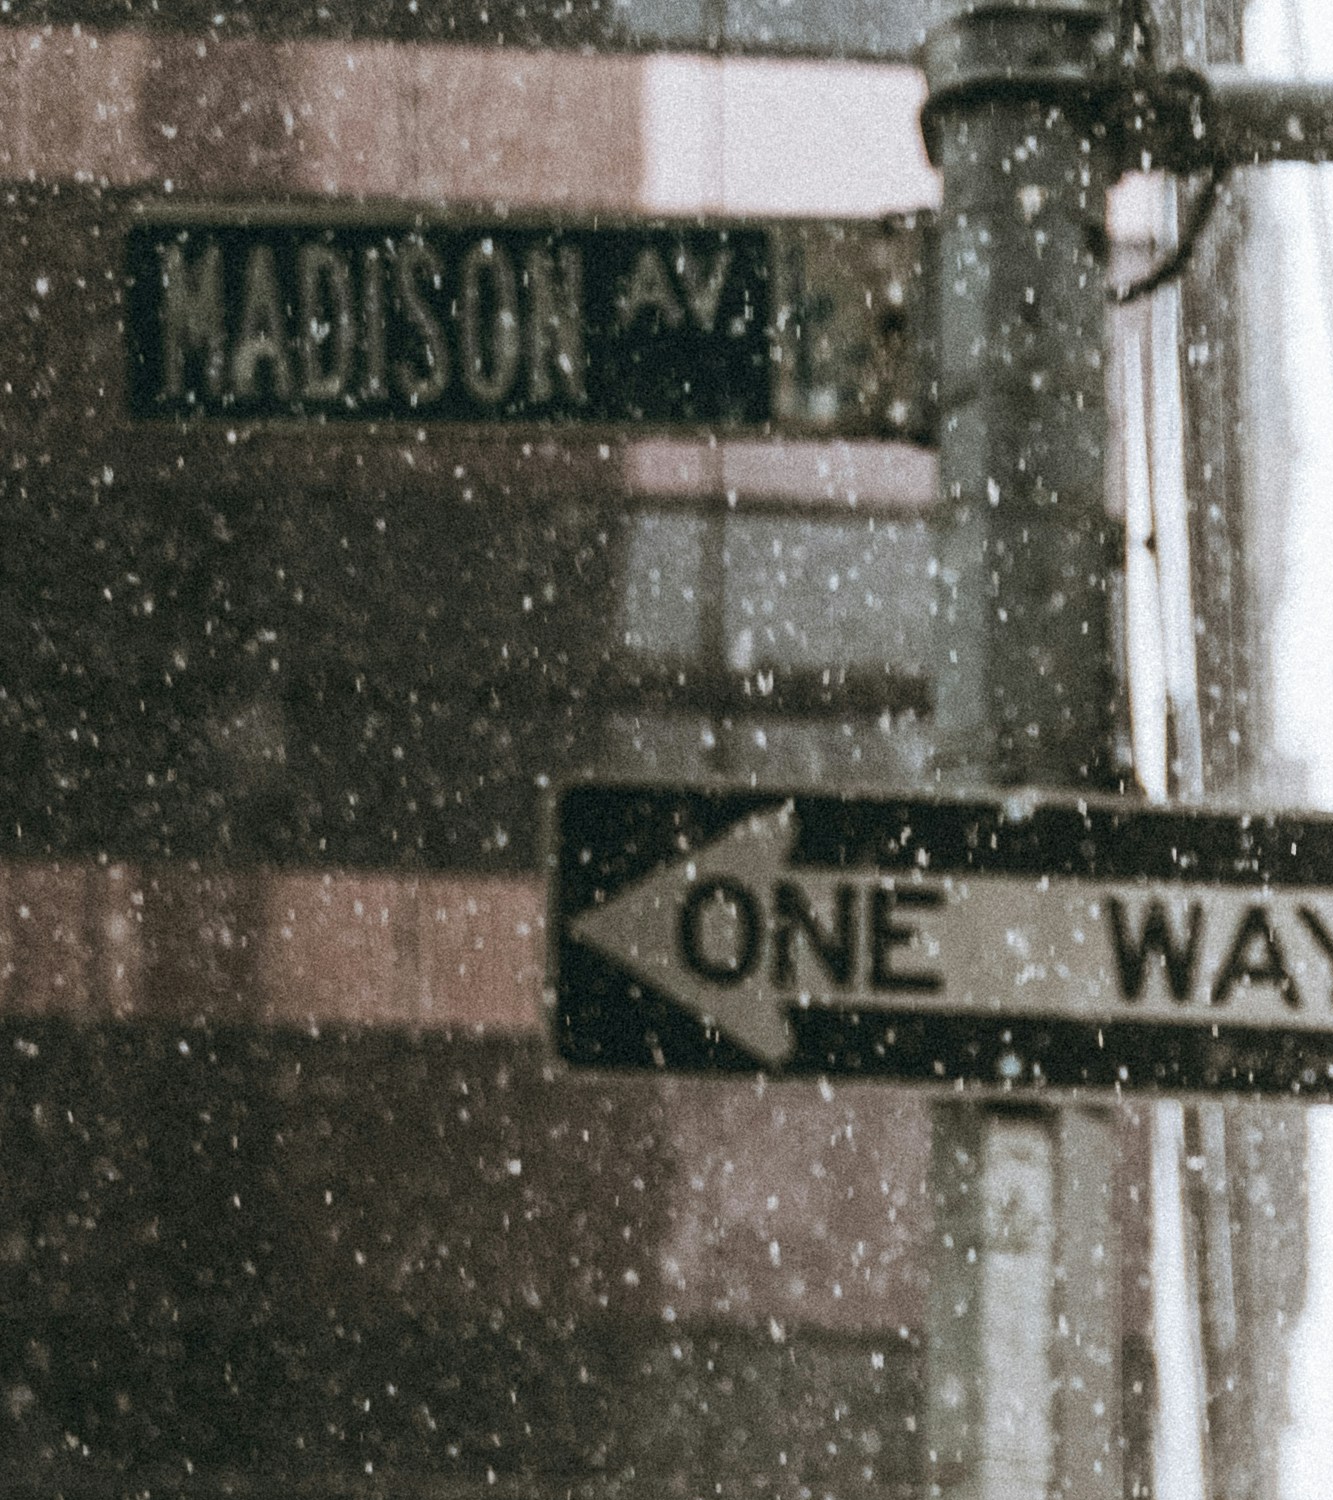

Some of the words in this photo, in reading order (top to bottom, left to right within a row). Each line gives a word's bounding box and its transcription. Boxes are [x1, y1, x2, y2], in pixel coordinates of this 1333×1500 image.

[157, 240, 588, 403] MADISON
[613, 248, 730, 332] AV
[676, 880, 946, 993] ONE
